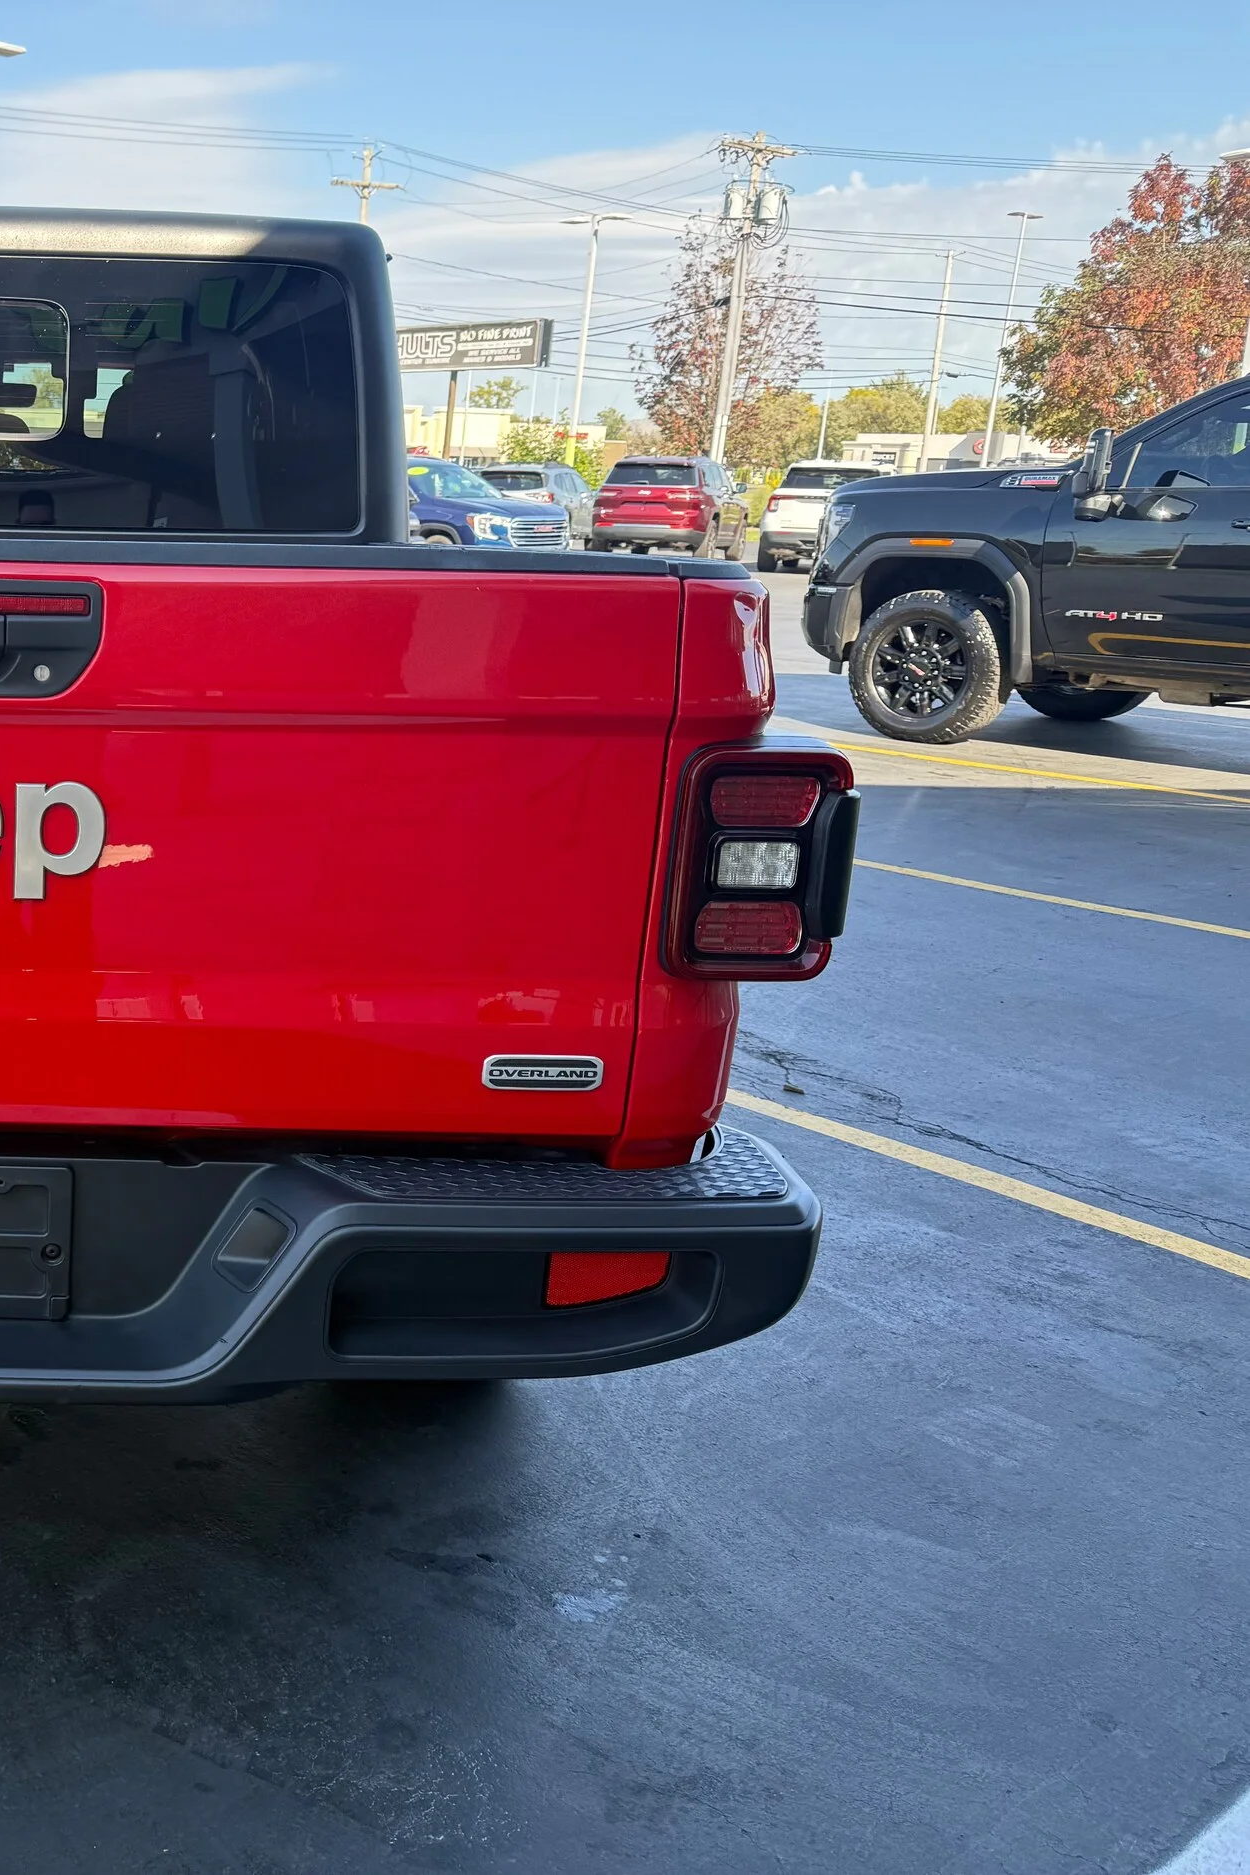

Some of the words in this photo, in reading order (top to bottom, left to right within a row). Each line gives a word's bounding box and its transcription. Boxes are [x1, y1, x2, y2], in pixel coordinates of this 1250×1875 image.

[459, 330, 476, 341] NO
[478, 328, 501, 340] FINE
[502, 325, 534, 338] PRINT
[1065, 609, 1118, 621] AT4
[1121, 611, 1163, 621] HD
[488, 1068, 598, 1079] OVERLAND
